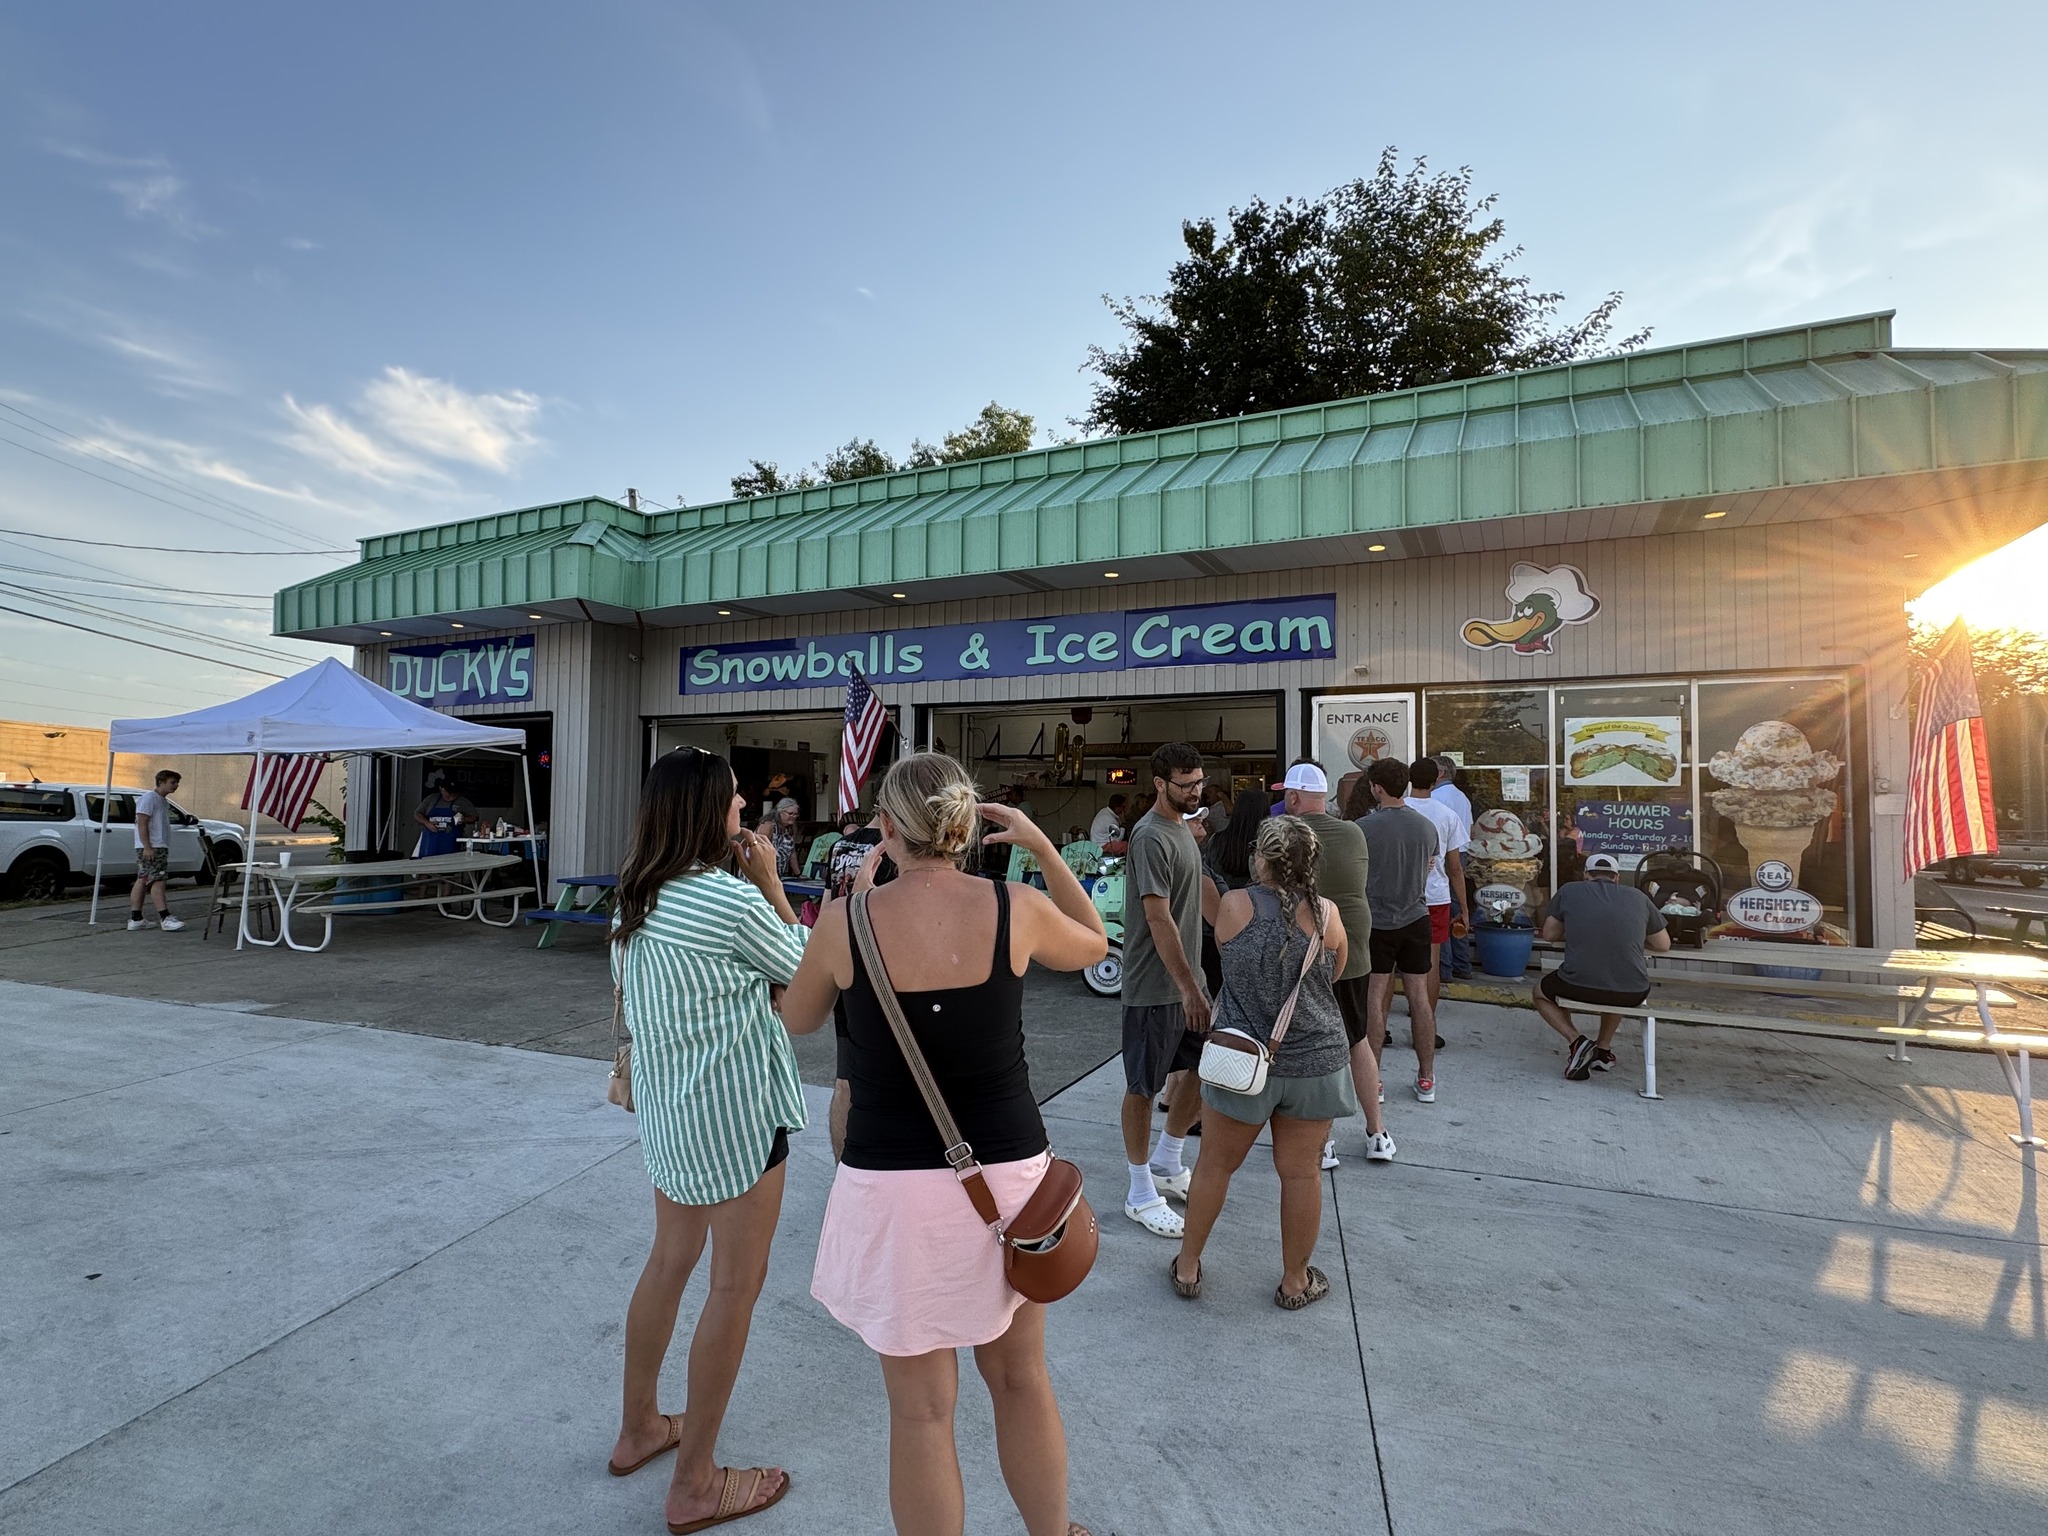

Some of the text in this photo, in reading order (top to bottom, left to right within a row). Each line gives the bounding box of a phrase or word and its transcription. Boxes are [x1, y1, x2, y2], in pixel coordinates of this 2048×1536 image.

[690, 614, 1333, 686] Snowballs & Ice Cream
[389, 637, 531, 699] DUCKY'S
[1326, 712, 1399, 725] ENTRANCE
[1201, 741, 1239, 750] REPAIR
[1602, 804, 1671, 817] SUMMER
[1608, 817, 1665, 830] HOURS
[1579, 830, 1614, 841] Monday
[1621, 832, 1667, 843] Saturday
[1600, 842, 1635, 852] Sunday
[1758, 871, 1790, 880] REAL
[1481, 890, 1520, 900] HERSHEY'S
[1740, 897, 1810, 912] HERSHEY'S
[1743, 911, 1807, 925] Ice Cream
